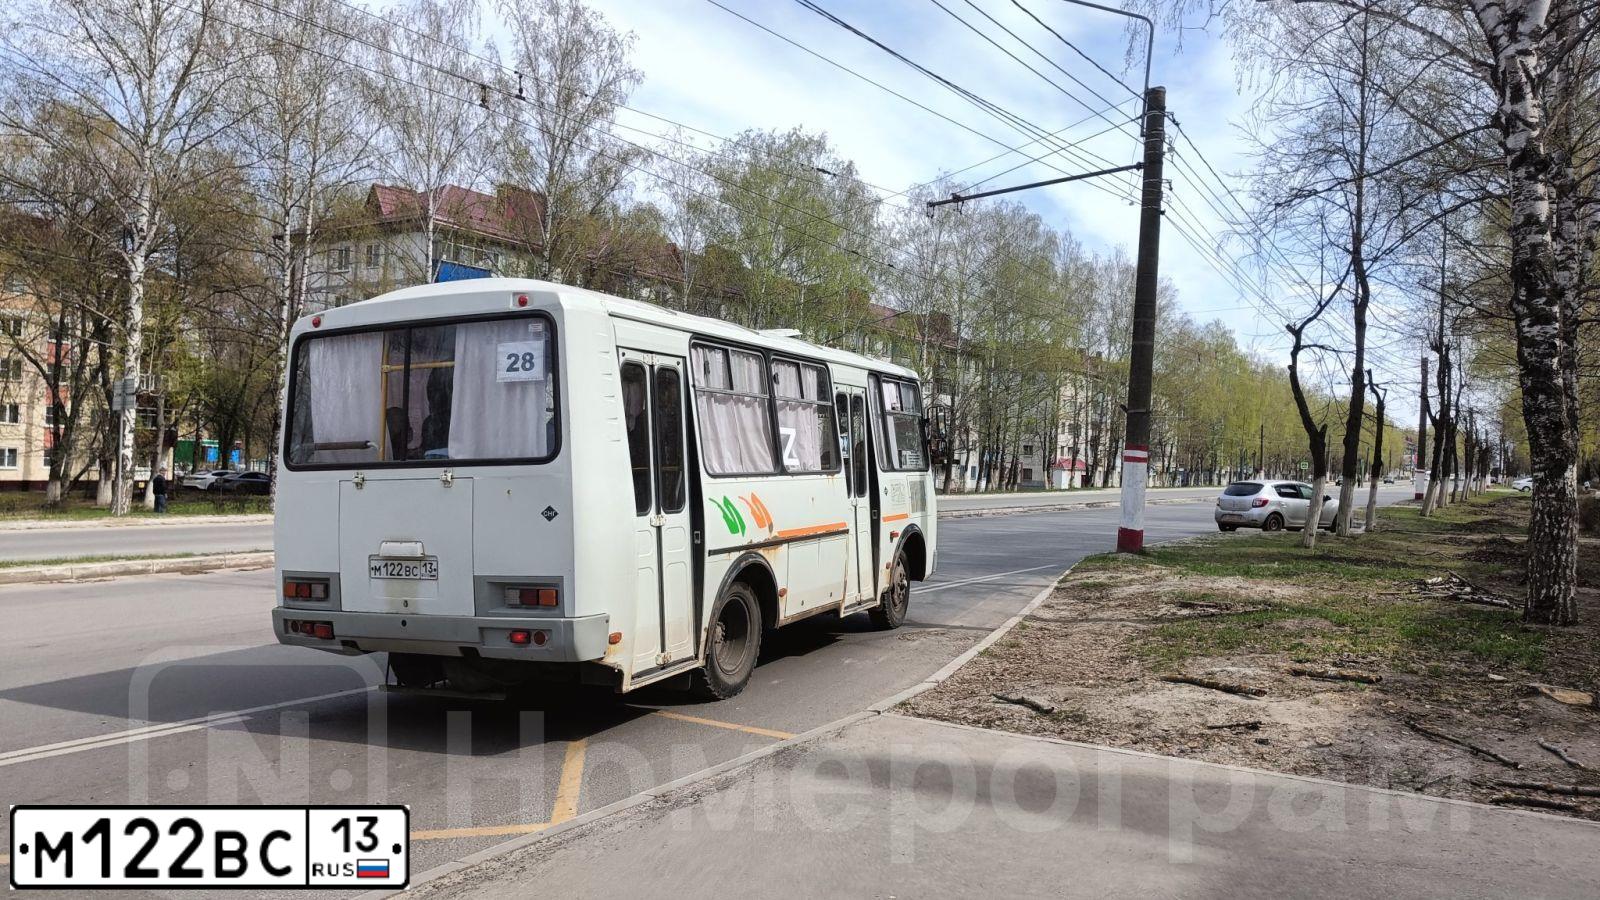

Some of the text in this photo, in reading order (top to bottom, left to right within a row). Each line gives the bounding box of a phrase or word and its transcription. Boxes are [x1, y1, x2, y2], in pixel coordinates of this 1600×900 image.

[506, 352, 535, 372] 28
[779, 426, 800, 466] Z
[374, 562, 433, 576] М122ВС 13
